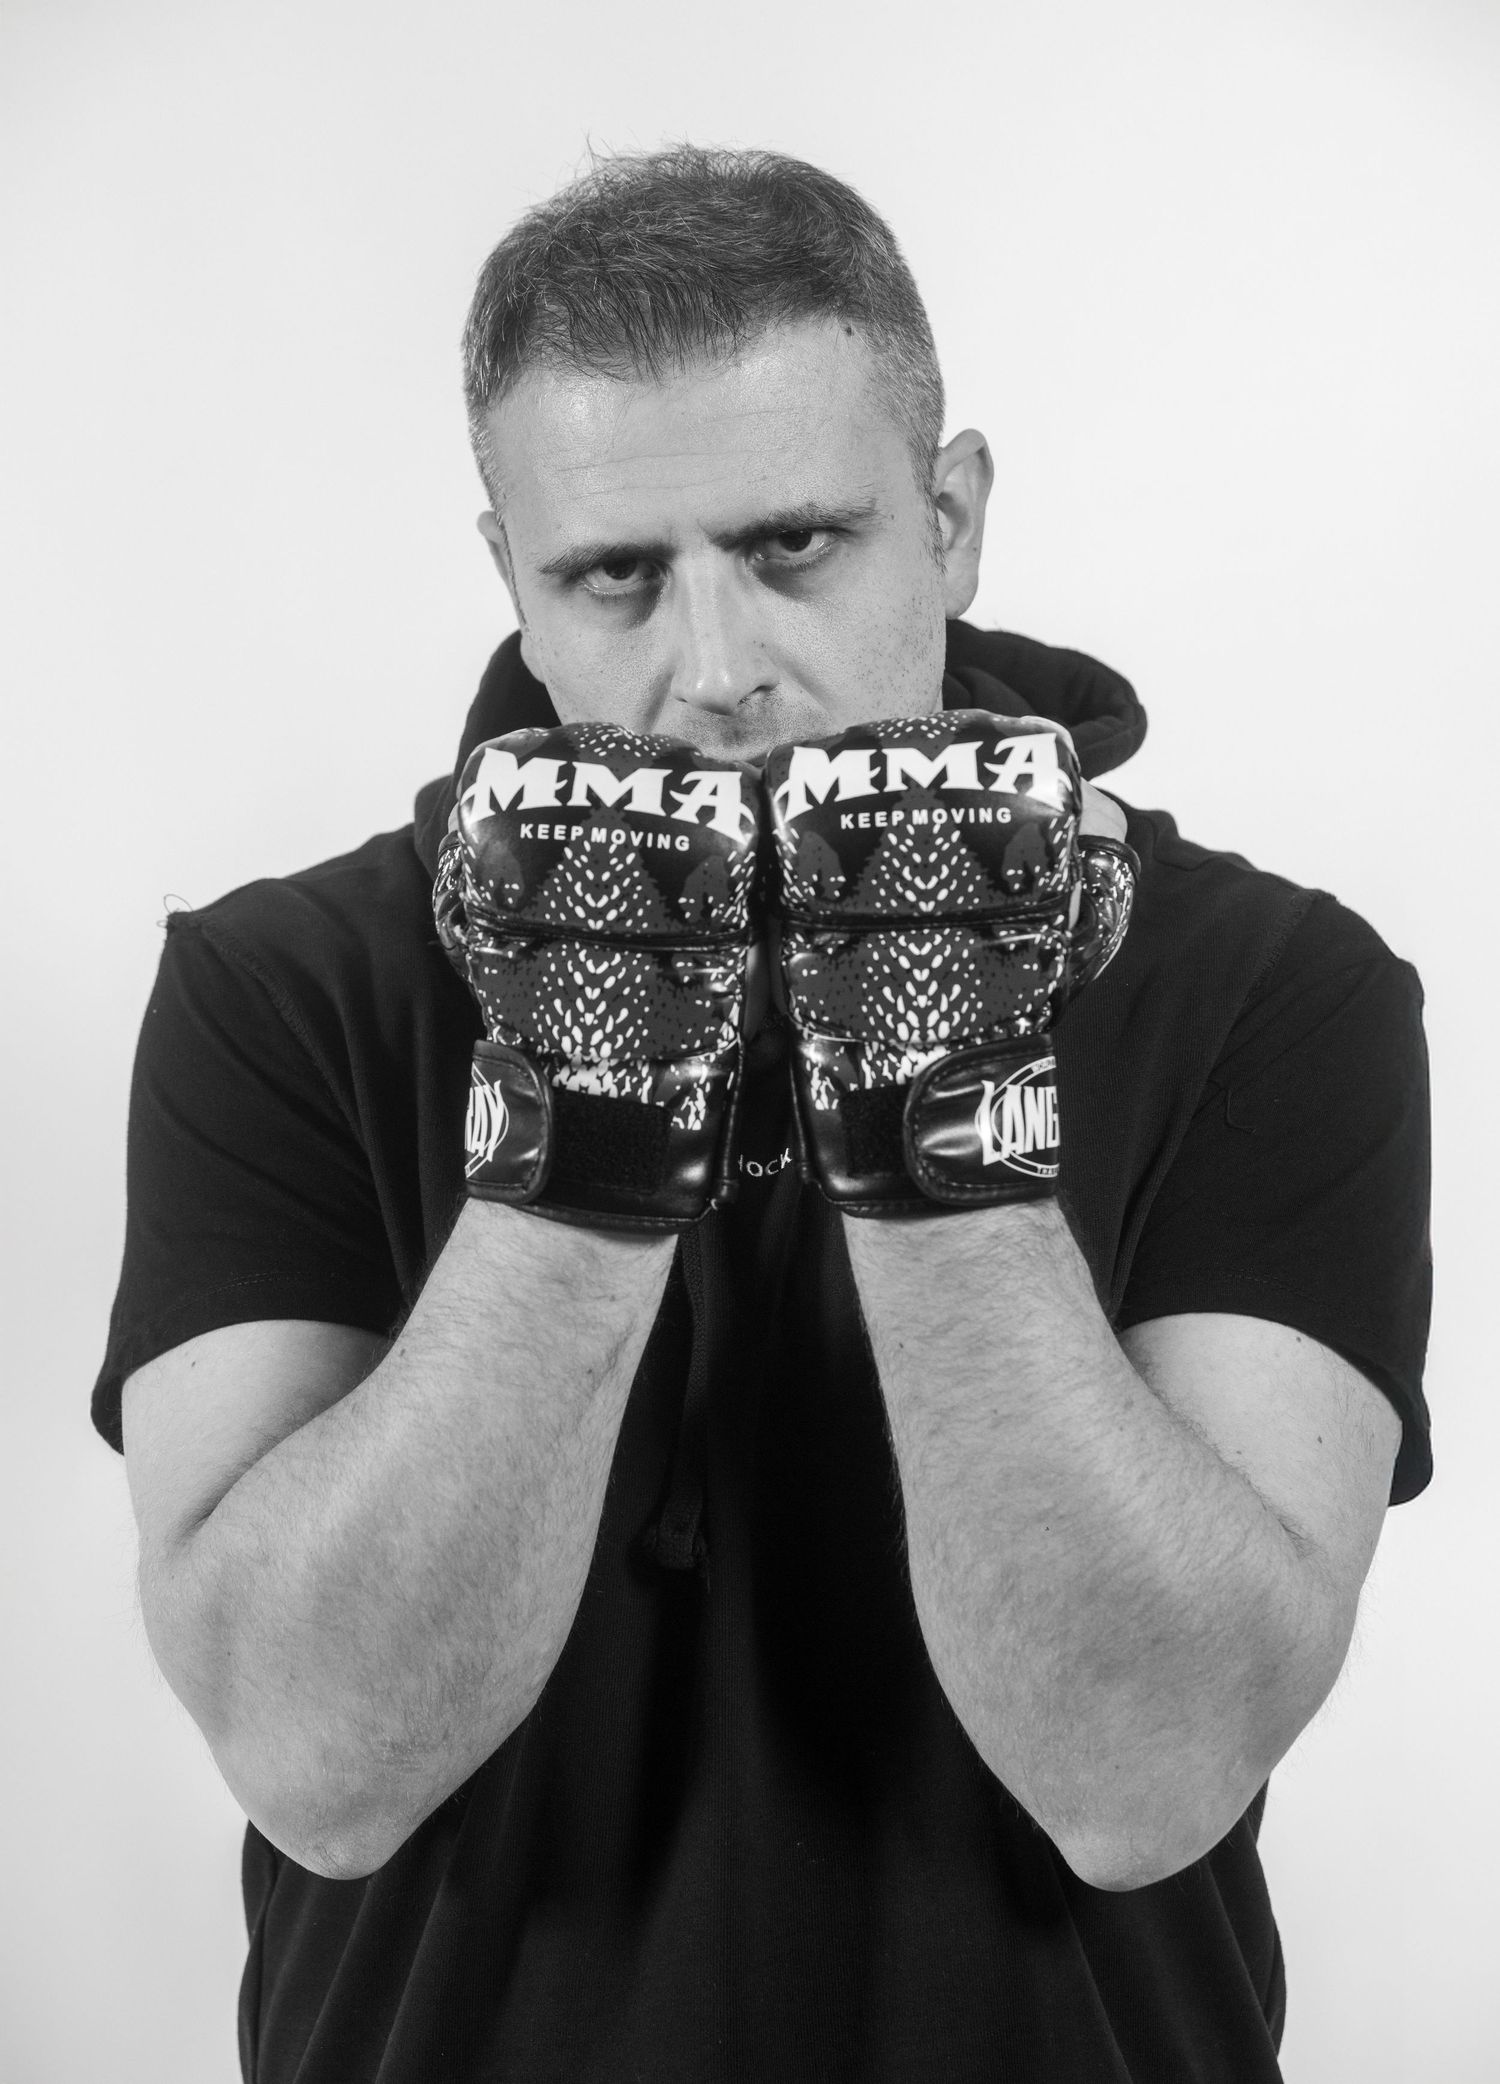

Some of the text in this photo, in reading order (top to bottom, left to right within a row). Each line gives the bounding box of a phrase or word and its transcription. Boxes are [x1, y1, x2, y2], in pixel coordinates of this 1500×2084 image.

[460, 747, 756, 846] MMA
[772, 732, 1073, 823] MMA
[520, 822, 691, 851] KEEP MOVING
[840, 807, 1012, 830] KEEP MOVING
